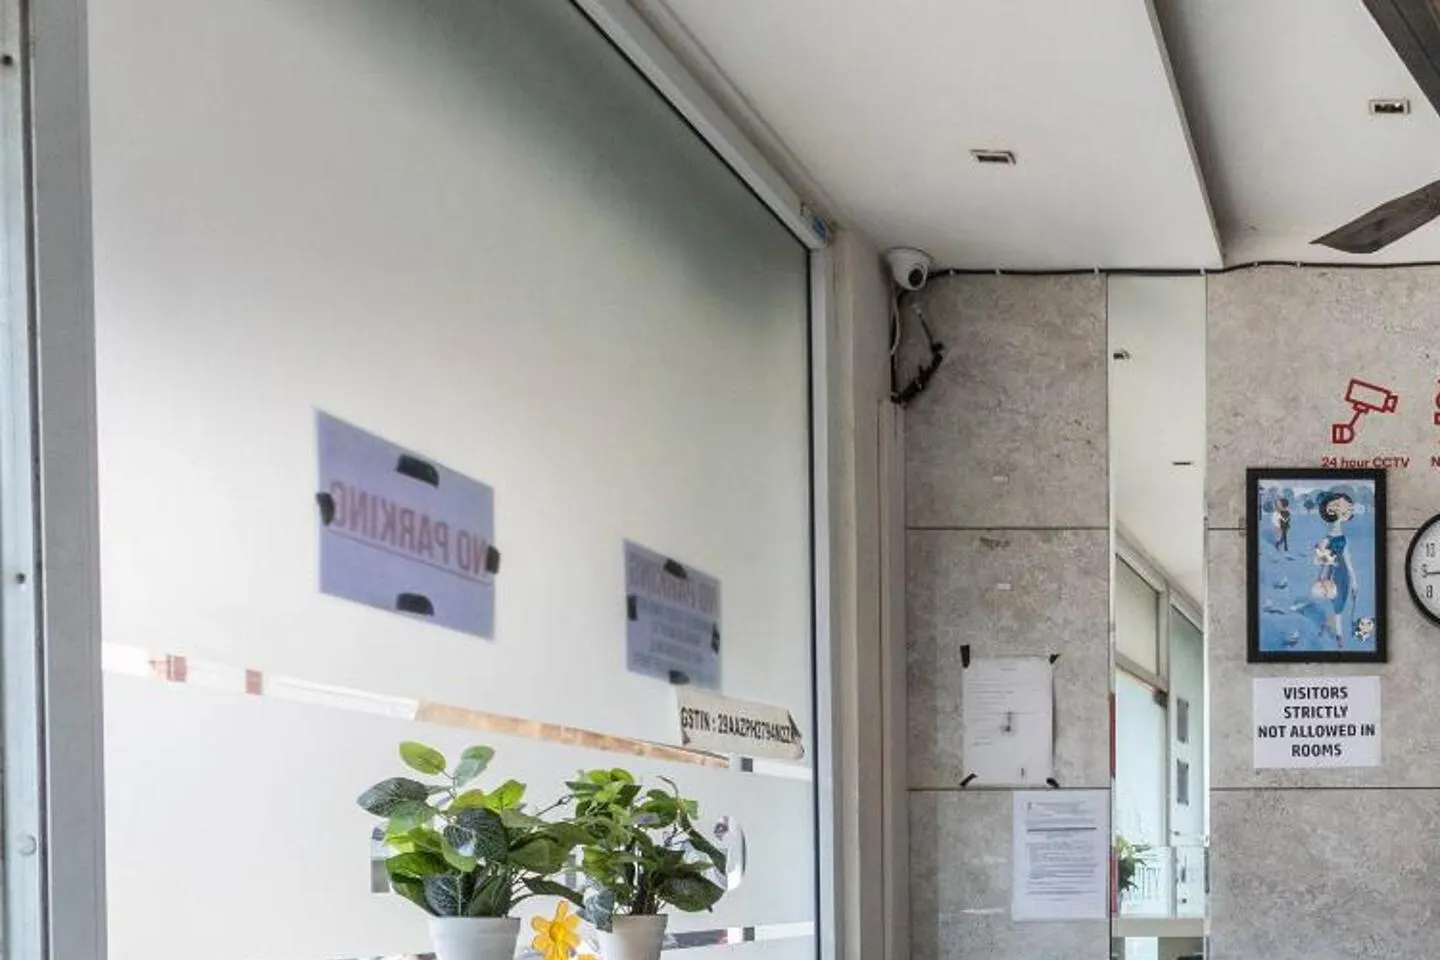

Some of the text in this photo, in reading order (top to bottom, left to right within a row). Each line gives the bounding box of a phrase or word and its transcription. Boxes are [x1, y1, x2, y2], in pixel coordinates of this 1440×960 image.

[1321, 457, 1410, 469] 24 hour CCTV
[1426, 584, 1434, 599] 8
[1283, 686, 1348, 700] VISITORS
[681, 706, 710, 732] GSTIN
[1284, 705, 1348, 719] STRICTLY
[1258, 723, 1376, 738] NOT ALLOWED IN
[1291, 744, 1342, 757] ROOMS
